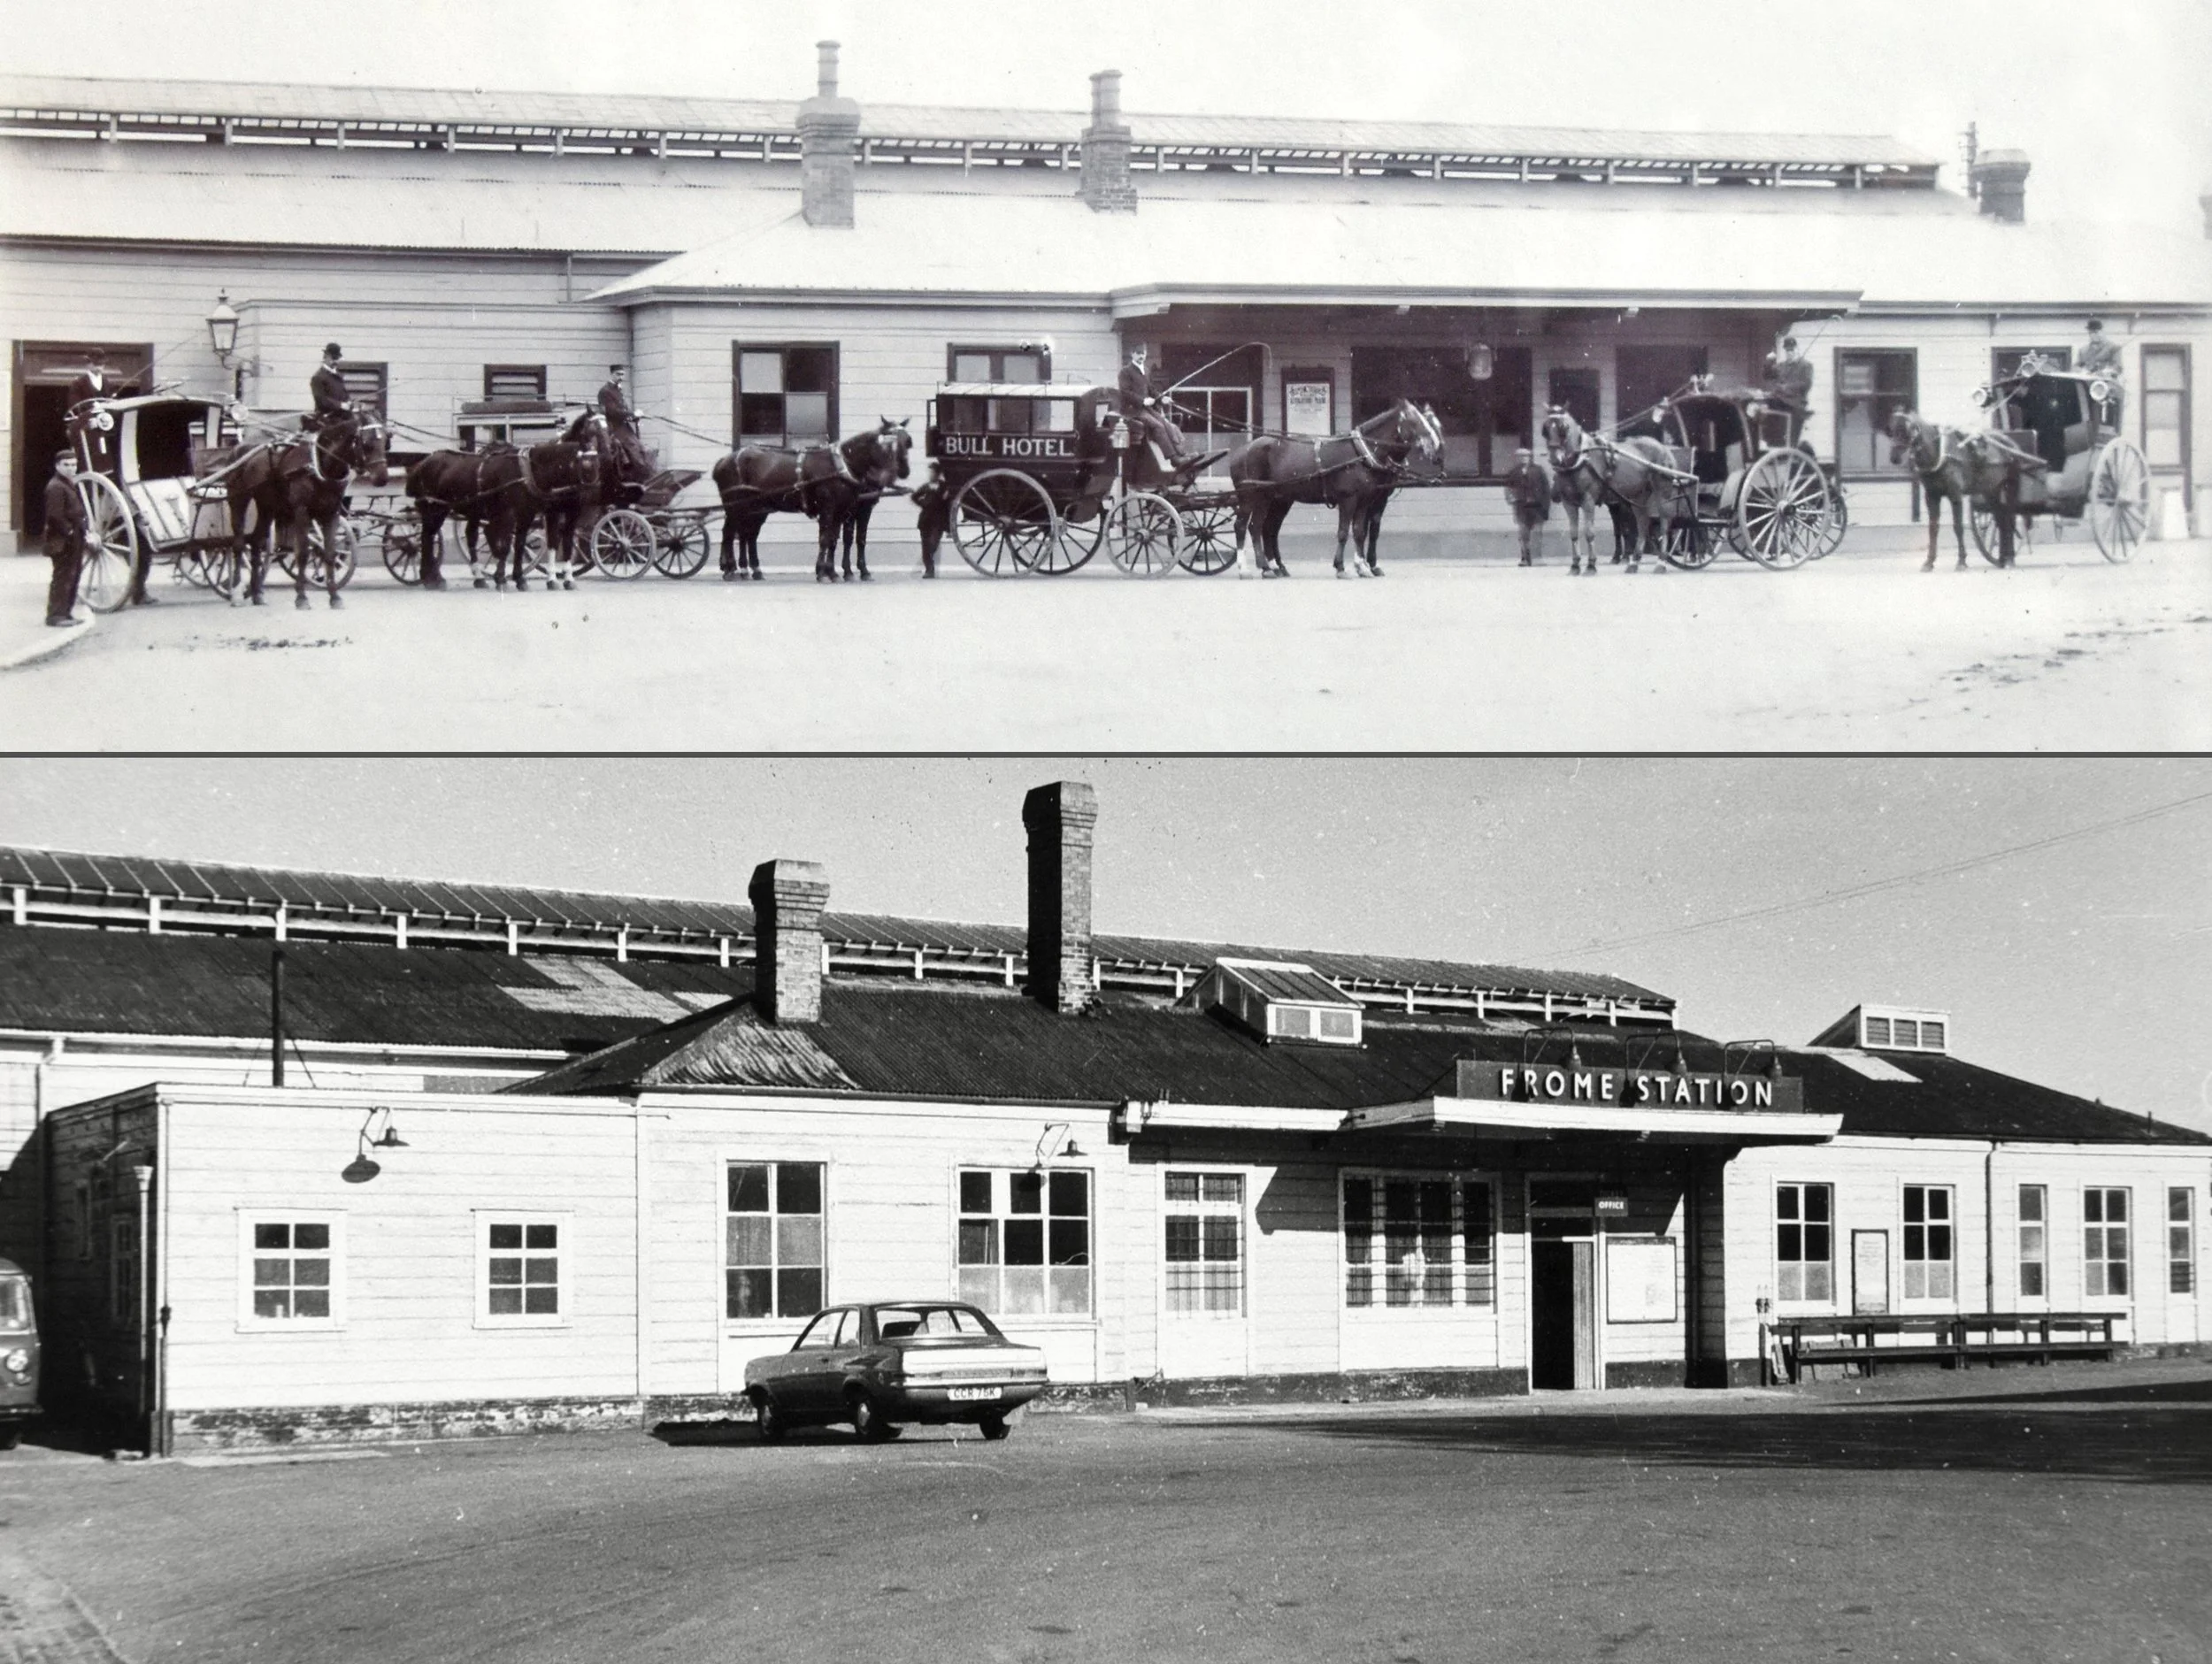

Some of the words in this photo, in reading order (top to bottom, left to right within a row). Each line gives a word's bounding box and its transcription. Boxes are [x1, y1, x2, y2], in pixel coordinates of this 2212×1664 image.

[945, 436, 993, 455] BULL
[1002, 438, 1074, 456] HOTEL
[1500, 1068, 1614, 1100] FROME
[1637, 1075, 1773, 1107] STATION
[1598, 1200, 1624, 1210] OFFICE
